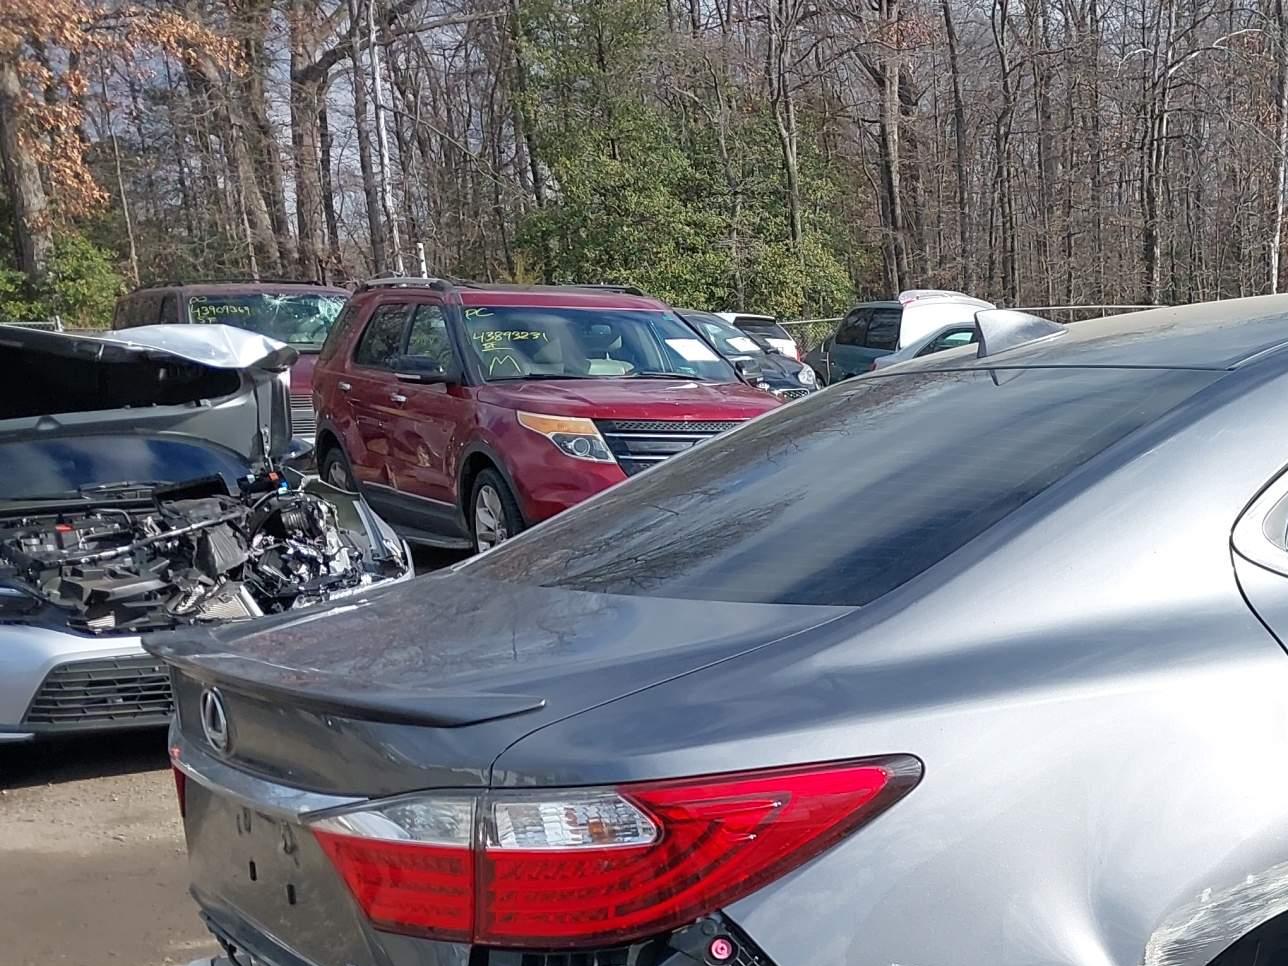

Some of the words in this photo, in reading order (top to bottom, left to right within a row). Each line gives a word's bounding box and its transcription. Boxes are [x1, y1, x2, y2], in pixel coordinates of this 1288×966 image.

[464, 308, 494, 320] PC
[473, 331, 549, 343] 43893231
[489, 354, 521, 376] M
